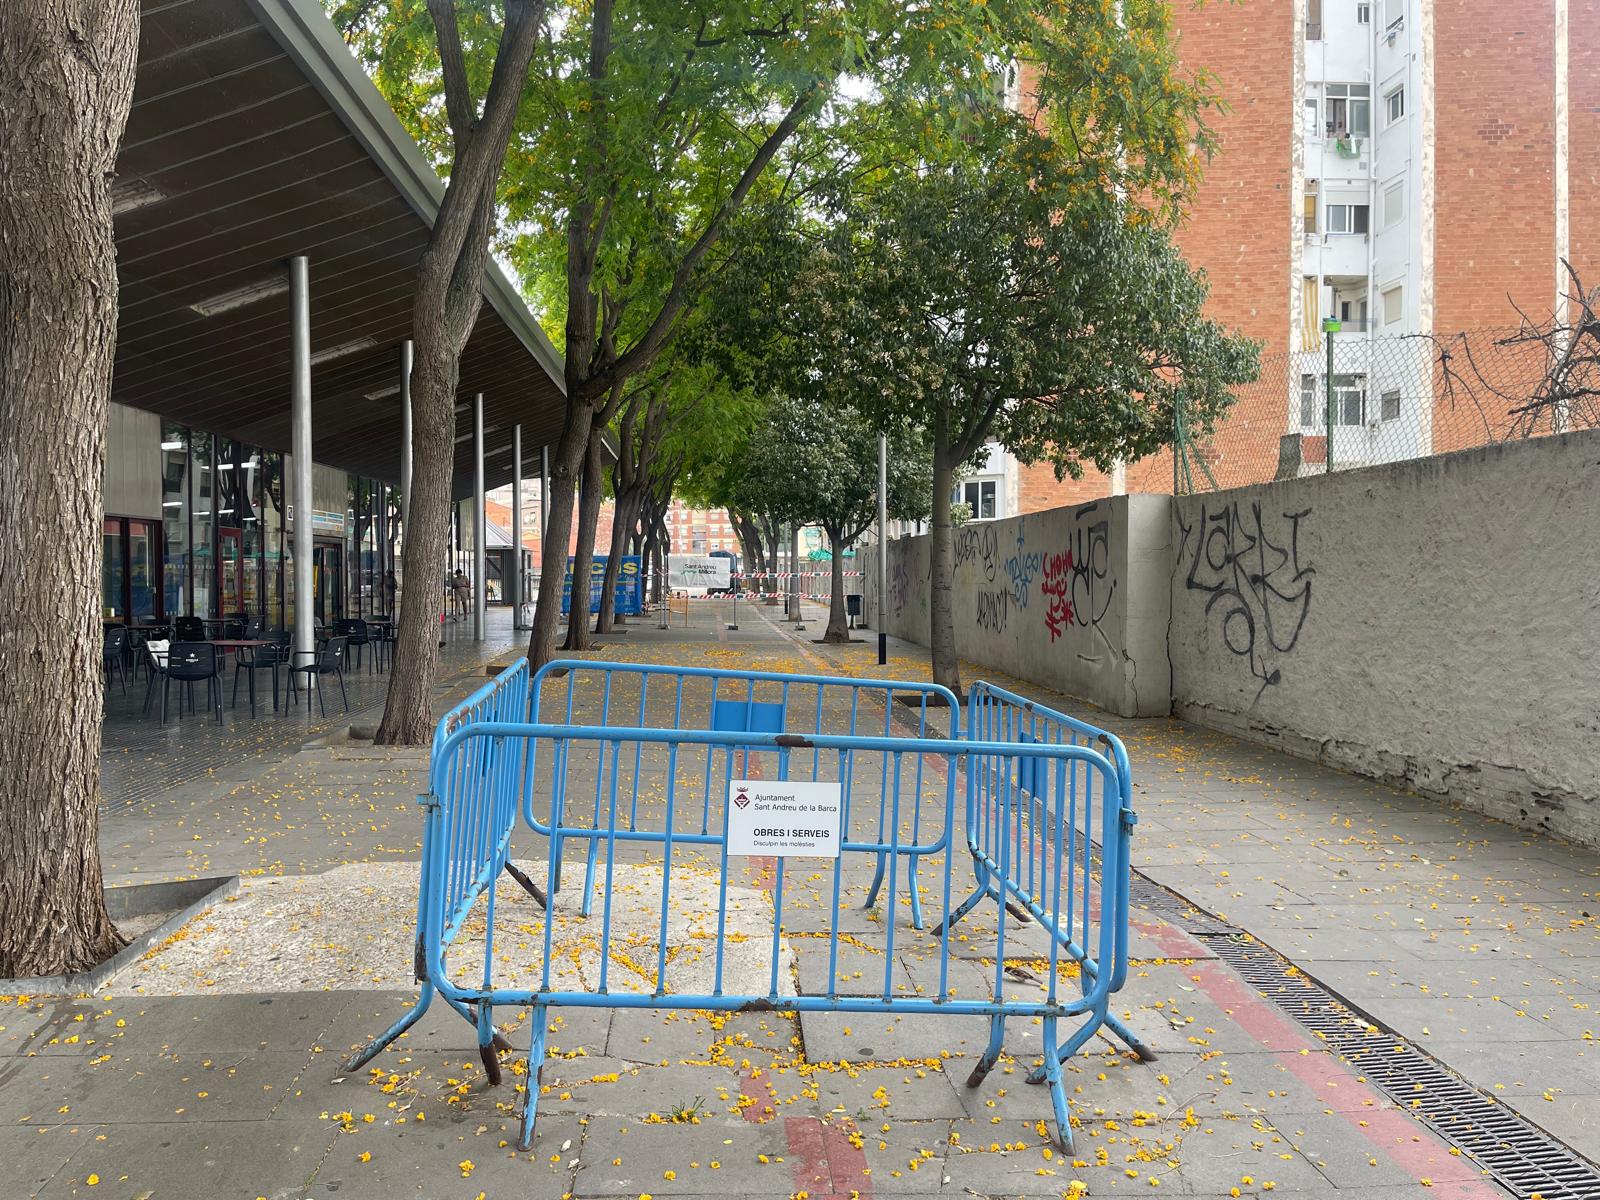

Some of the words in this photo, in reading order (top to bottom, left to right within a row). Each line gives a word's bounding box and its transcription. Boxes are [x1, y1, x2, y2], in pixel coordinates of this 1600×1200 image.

[754, 794, 795, 802] Ajuntament
[754, 803, 770, 811] Sant
[772, 803, 797, 812] Andreu
[798, 804, 808, 812] de
[809, 804, 816, 812] la
[817, 805, 837, 813] Barca
[753, 828, 785, 837] OBRES
[792, 829, 830, 838] SERVEIS
[753, 840, 778, 848] Disculpin
